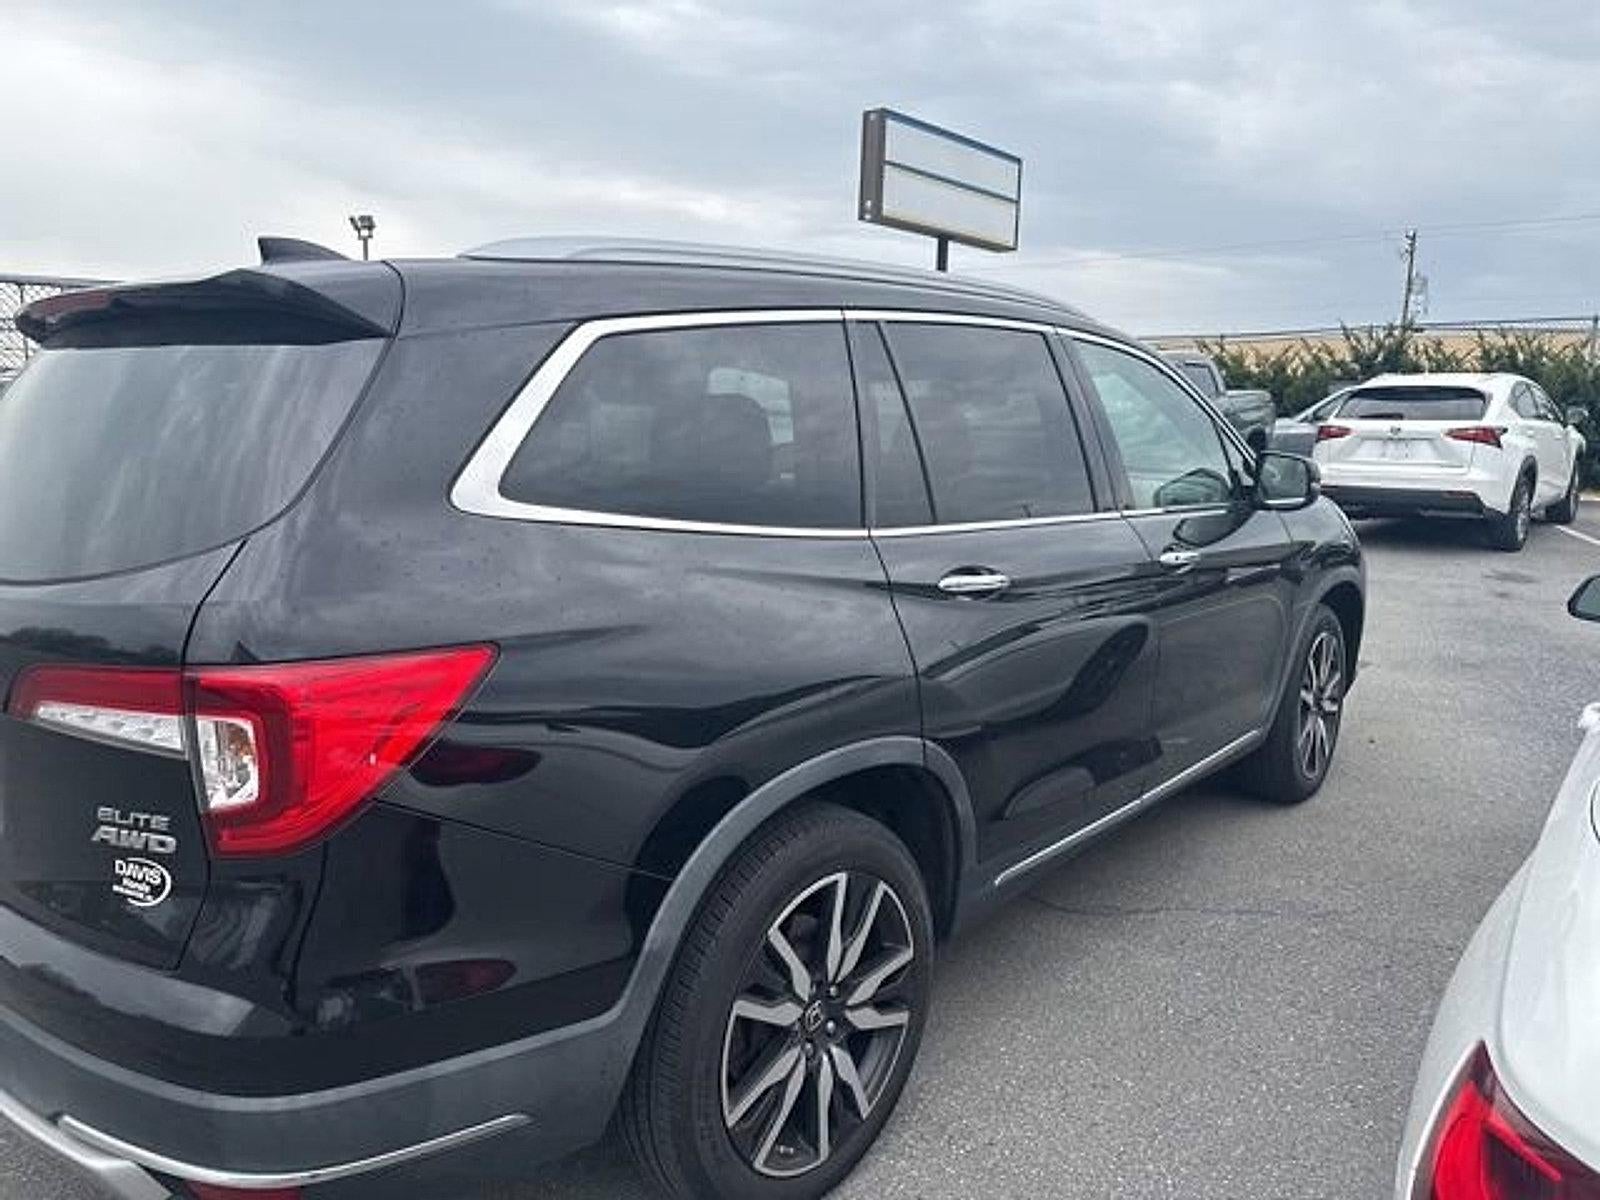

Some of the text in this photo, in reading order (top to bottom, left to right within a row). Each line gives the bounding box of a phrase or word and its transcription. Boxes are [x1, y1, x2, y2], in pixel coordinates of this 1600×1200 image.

[97, 807, 170, 830] ELITE
[91, 825, 176, 853] AWD
[114, 860, 161, 884] DAVIS
